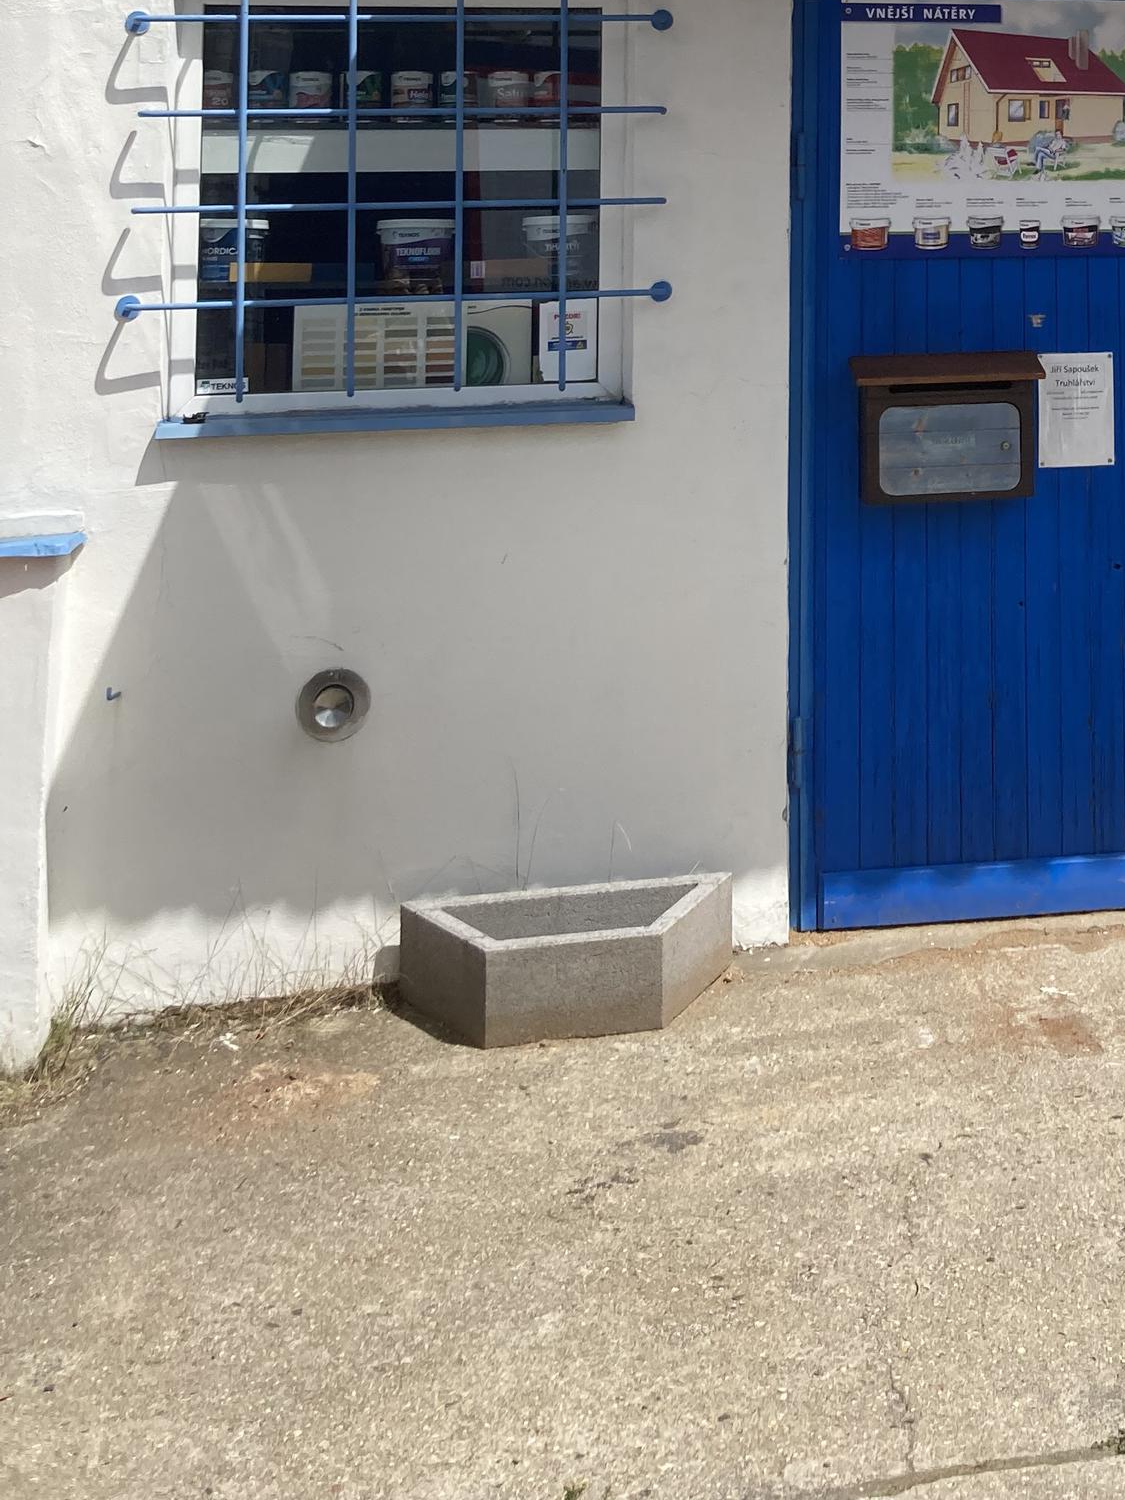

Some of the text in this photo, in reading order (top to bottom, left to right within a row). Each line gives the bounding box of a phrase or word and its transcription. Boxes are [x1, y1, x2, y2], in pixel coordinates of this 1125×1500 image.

[865, 5, 977, 22] VNĚJŠÍ NÁTĚRY
[202, 246, 238, 256] ORDIC
[554, 312, 581, 321] PZOR!
[210, 381, 247, 391] TEKNS
